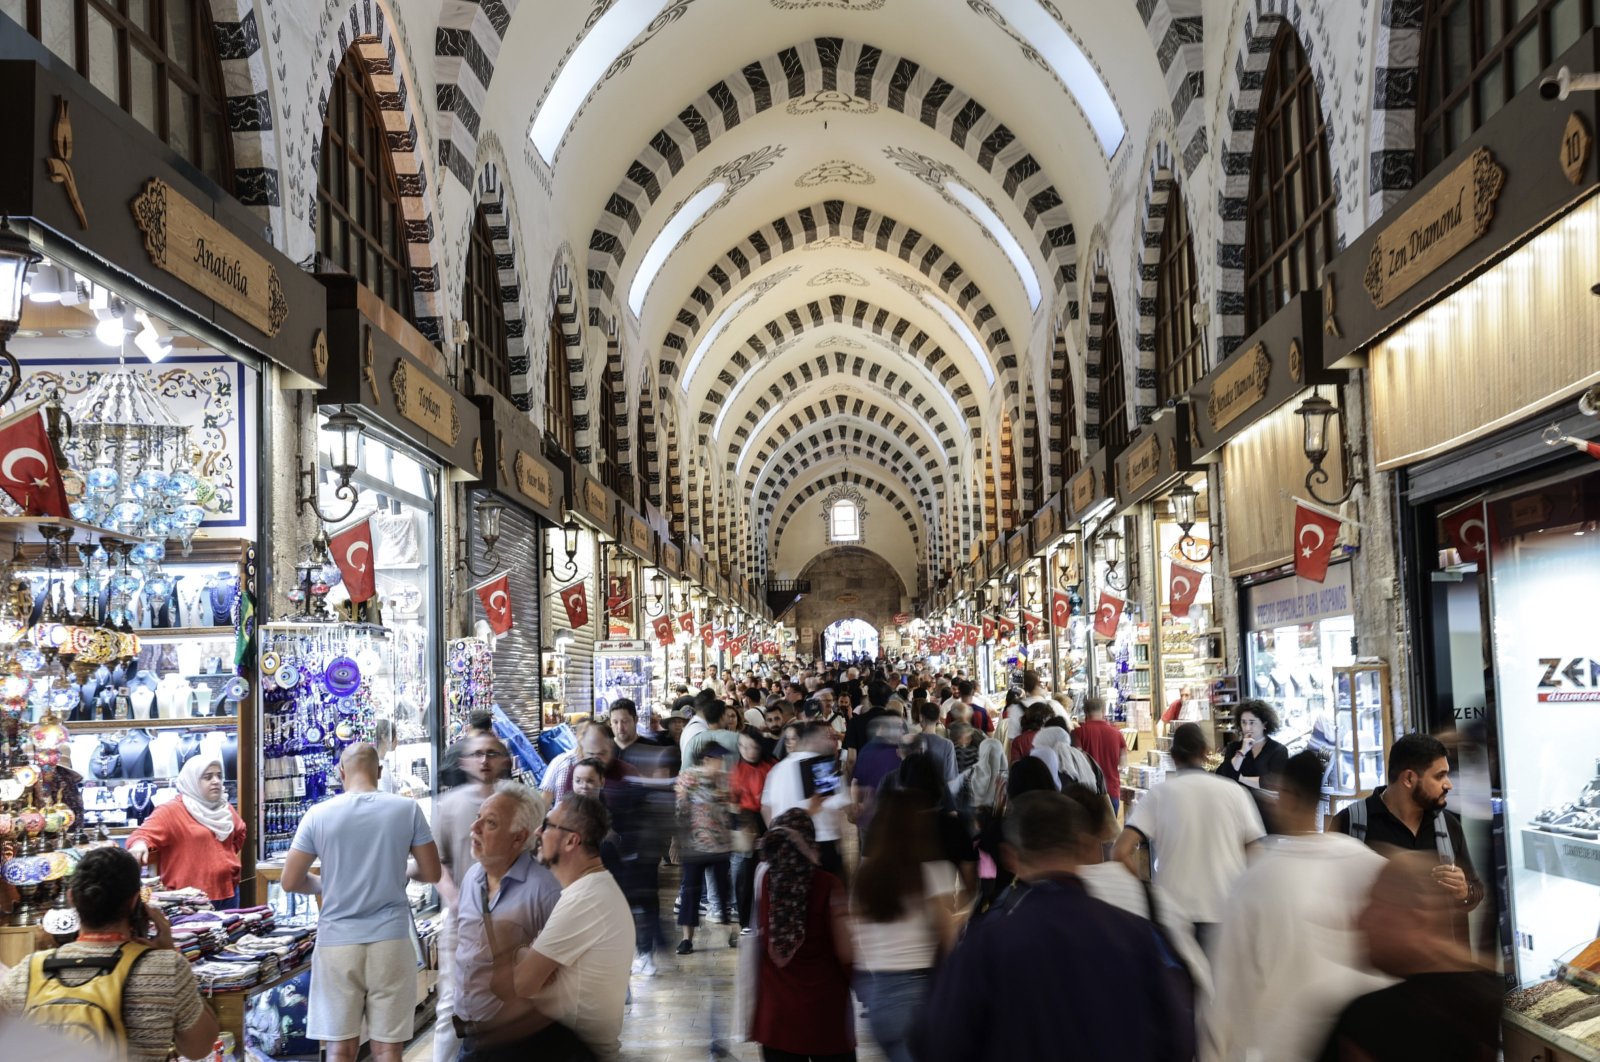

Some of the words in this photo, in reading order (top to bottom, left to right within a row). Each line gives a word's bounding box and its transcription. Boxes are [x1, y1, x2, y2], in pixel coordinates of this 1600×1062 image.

[1566, 130, 1580, 168] 10
[1388, 246, 1407, 278] Zen
[1409, 185, 1465, 261] Diamond
[193, 238, 249, 297] Anatolia
[1305, 591, 1319, 616] PARA
[1319, 584, 1347, 613] HISPANOS
[1452, 706, 1485, 720] ZEN
[1547, 690, 1600, 702] diamon
